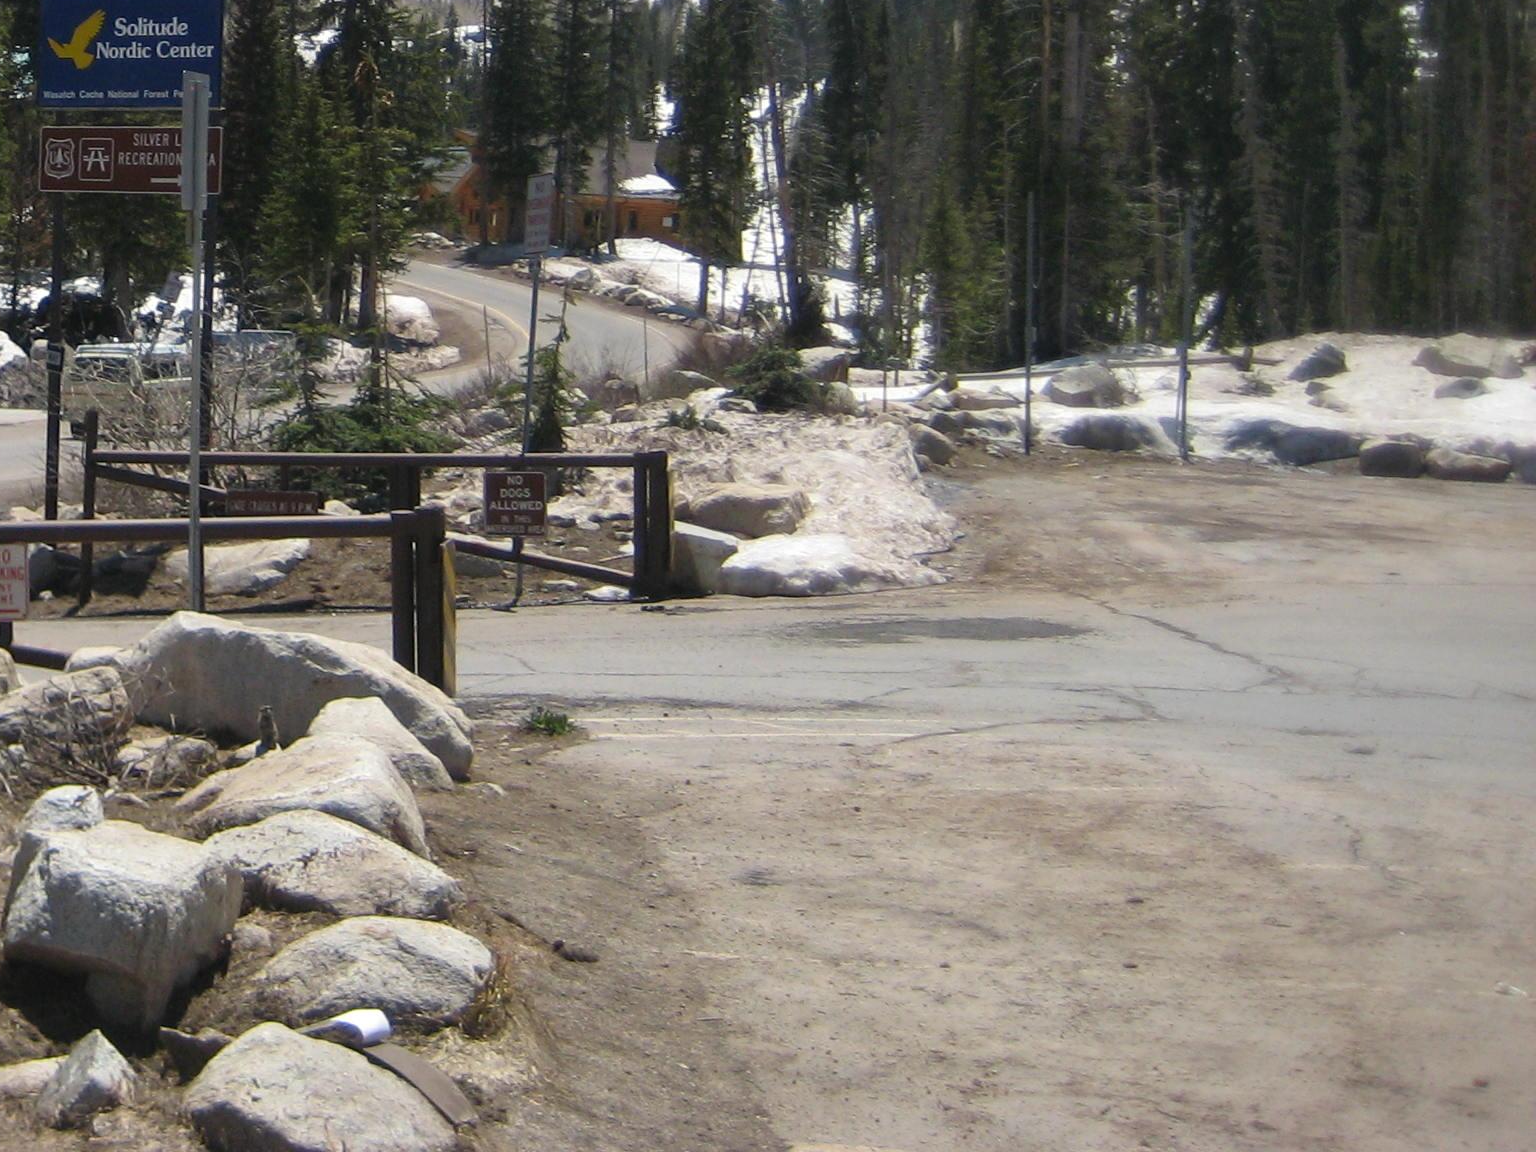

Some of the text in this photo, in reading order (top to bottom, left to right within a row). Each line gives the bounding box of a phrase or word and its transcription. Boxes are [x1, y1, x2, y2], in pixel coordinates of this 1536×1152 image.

[114, 16, 188, 36] Solitude
[96, 41, 214, 59] Nordic Center
[43, 90, 75, 98] Wasatch
[79, 90, 104, 98] Cache
[107, 89, 139, 98] National
[143, 89, 168, 98] Forest
[133, 133, 169, 146] SILVER
[118, 152, 182, 165] RECREATION
[507, 475, 524, 486] NO
[499, 488, 531, 498] DOGS
[489, 501, 544, 510] ALLOWED
